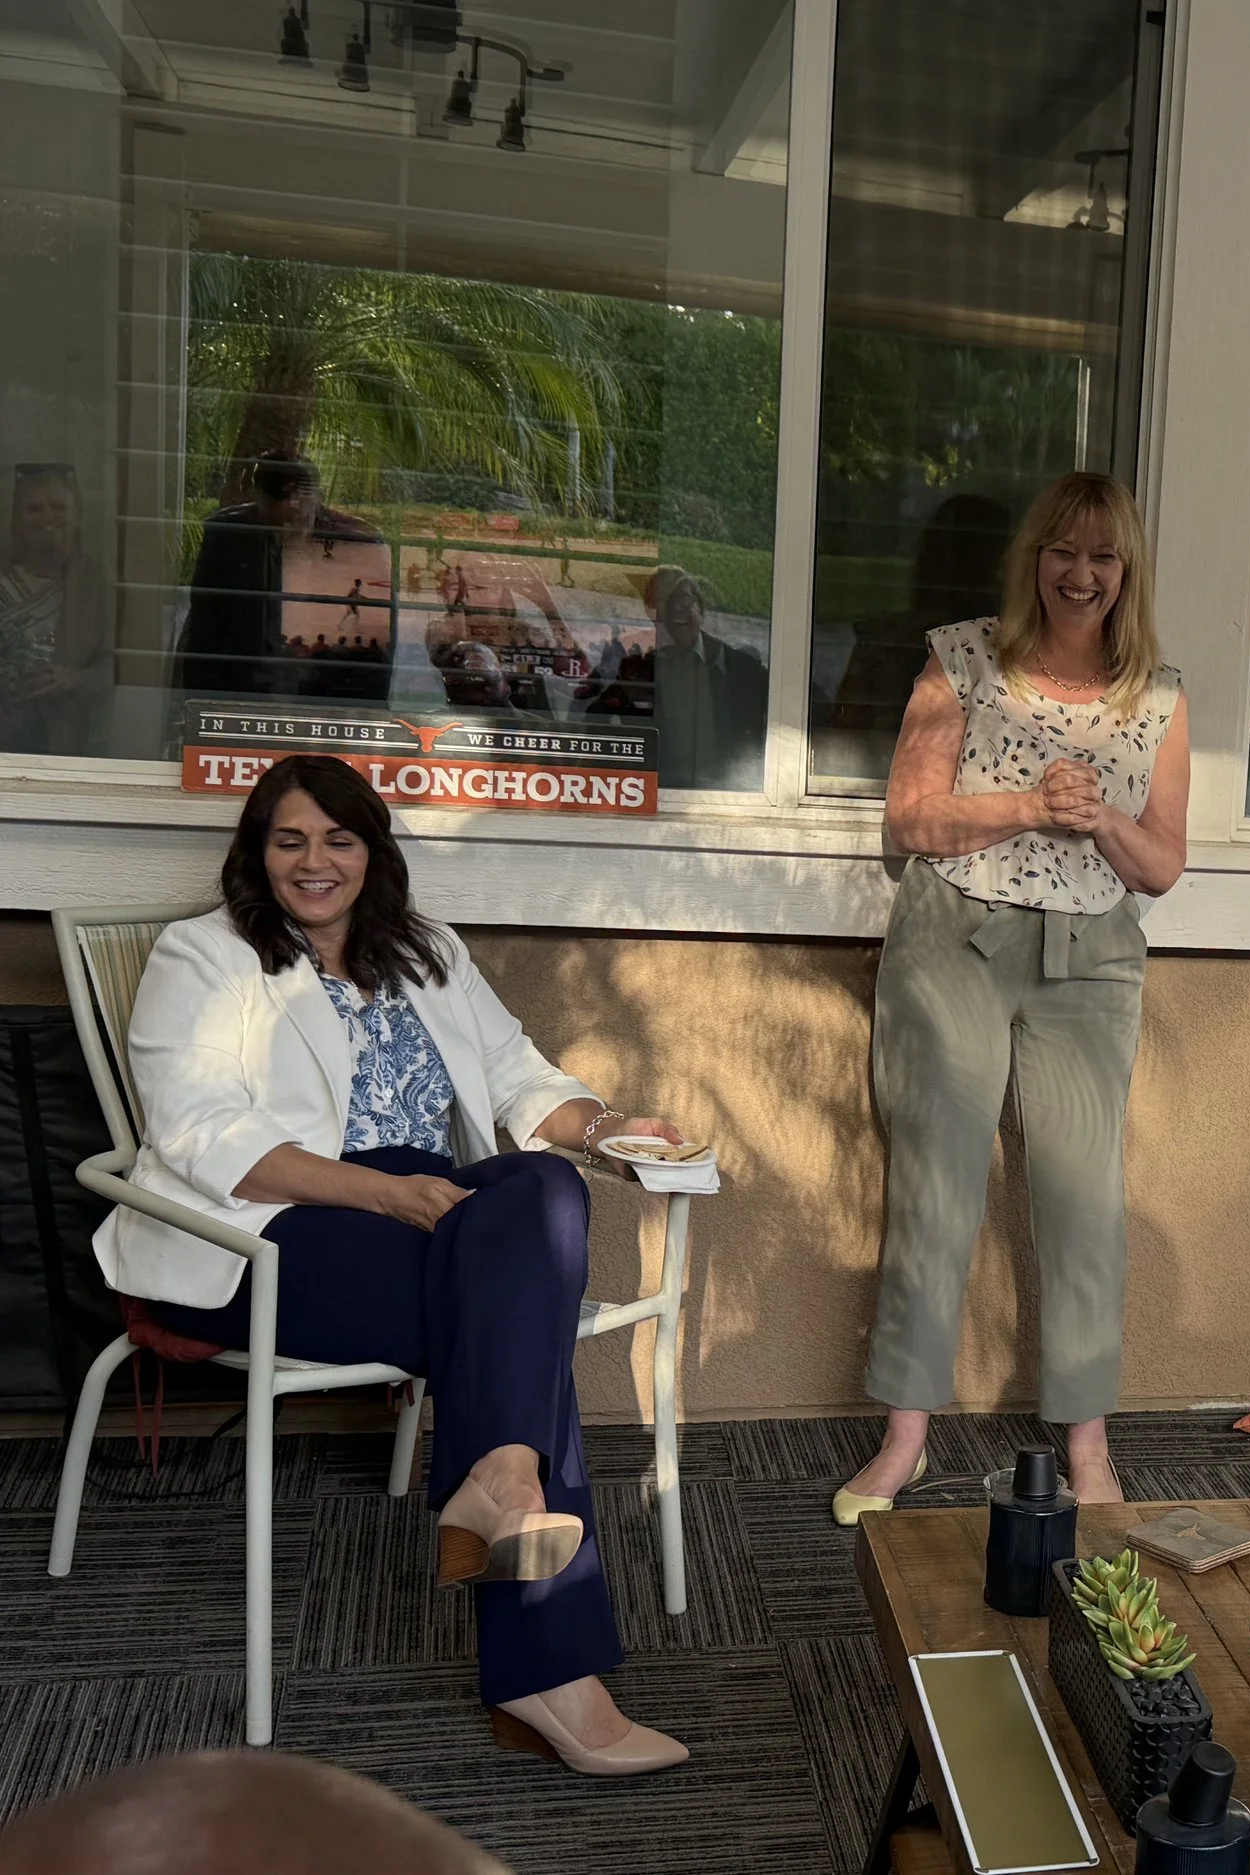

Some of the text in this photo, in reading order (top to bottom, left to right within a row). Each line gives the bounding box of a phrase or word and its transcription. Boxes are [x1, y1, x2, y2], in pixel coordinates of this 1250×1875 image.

[200, 718, 645, 756] IN THIS HOUSE WE CHEER FOR THE
[371, 763, 646, 808] LONGHORNS
